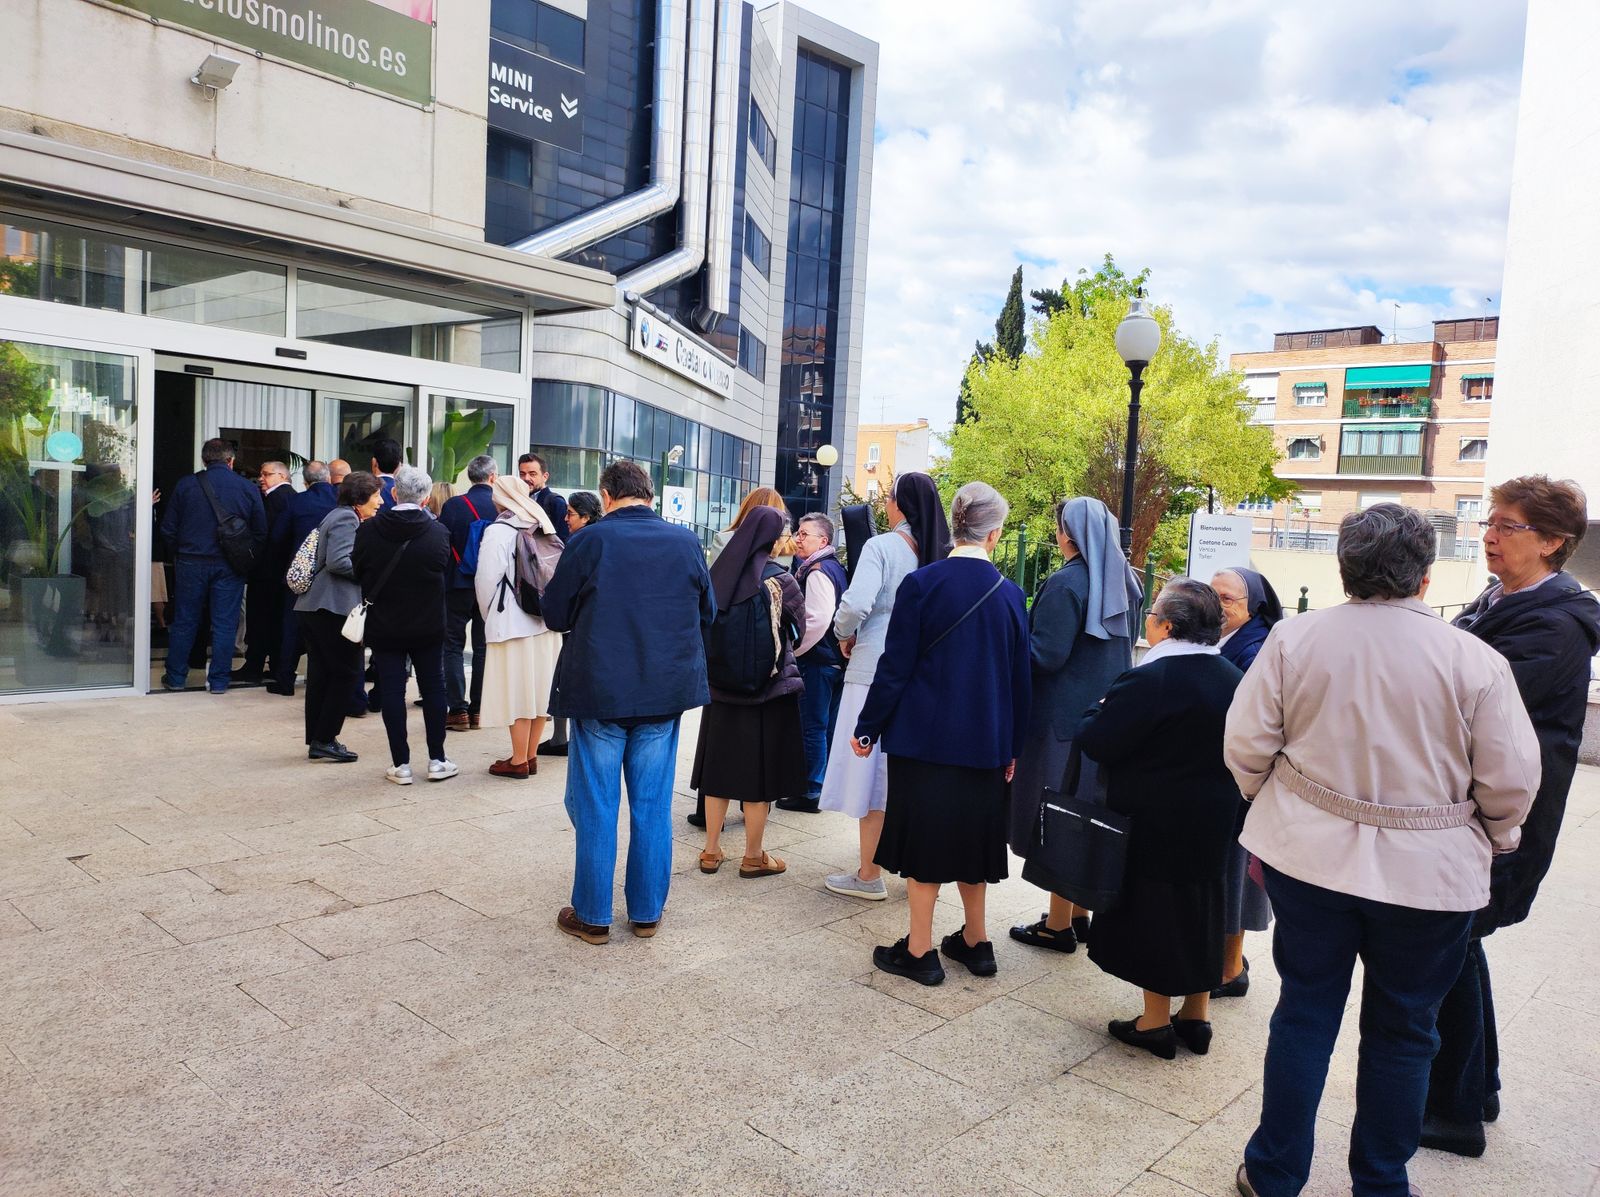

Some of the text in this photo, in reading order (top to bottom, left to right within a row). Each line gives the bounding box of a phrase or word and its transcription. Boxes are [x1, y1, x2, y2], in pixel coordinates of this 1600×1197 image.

[183, 0, 407, 76] osmolinos.es
[491, 62, 533, 93] MINI
[489, 85, 553, 123] Service
